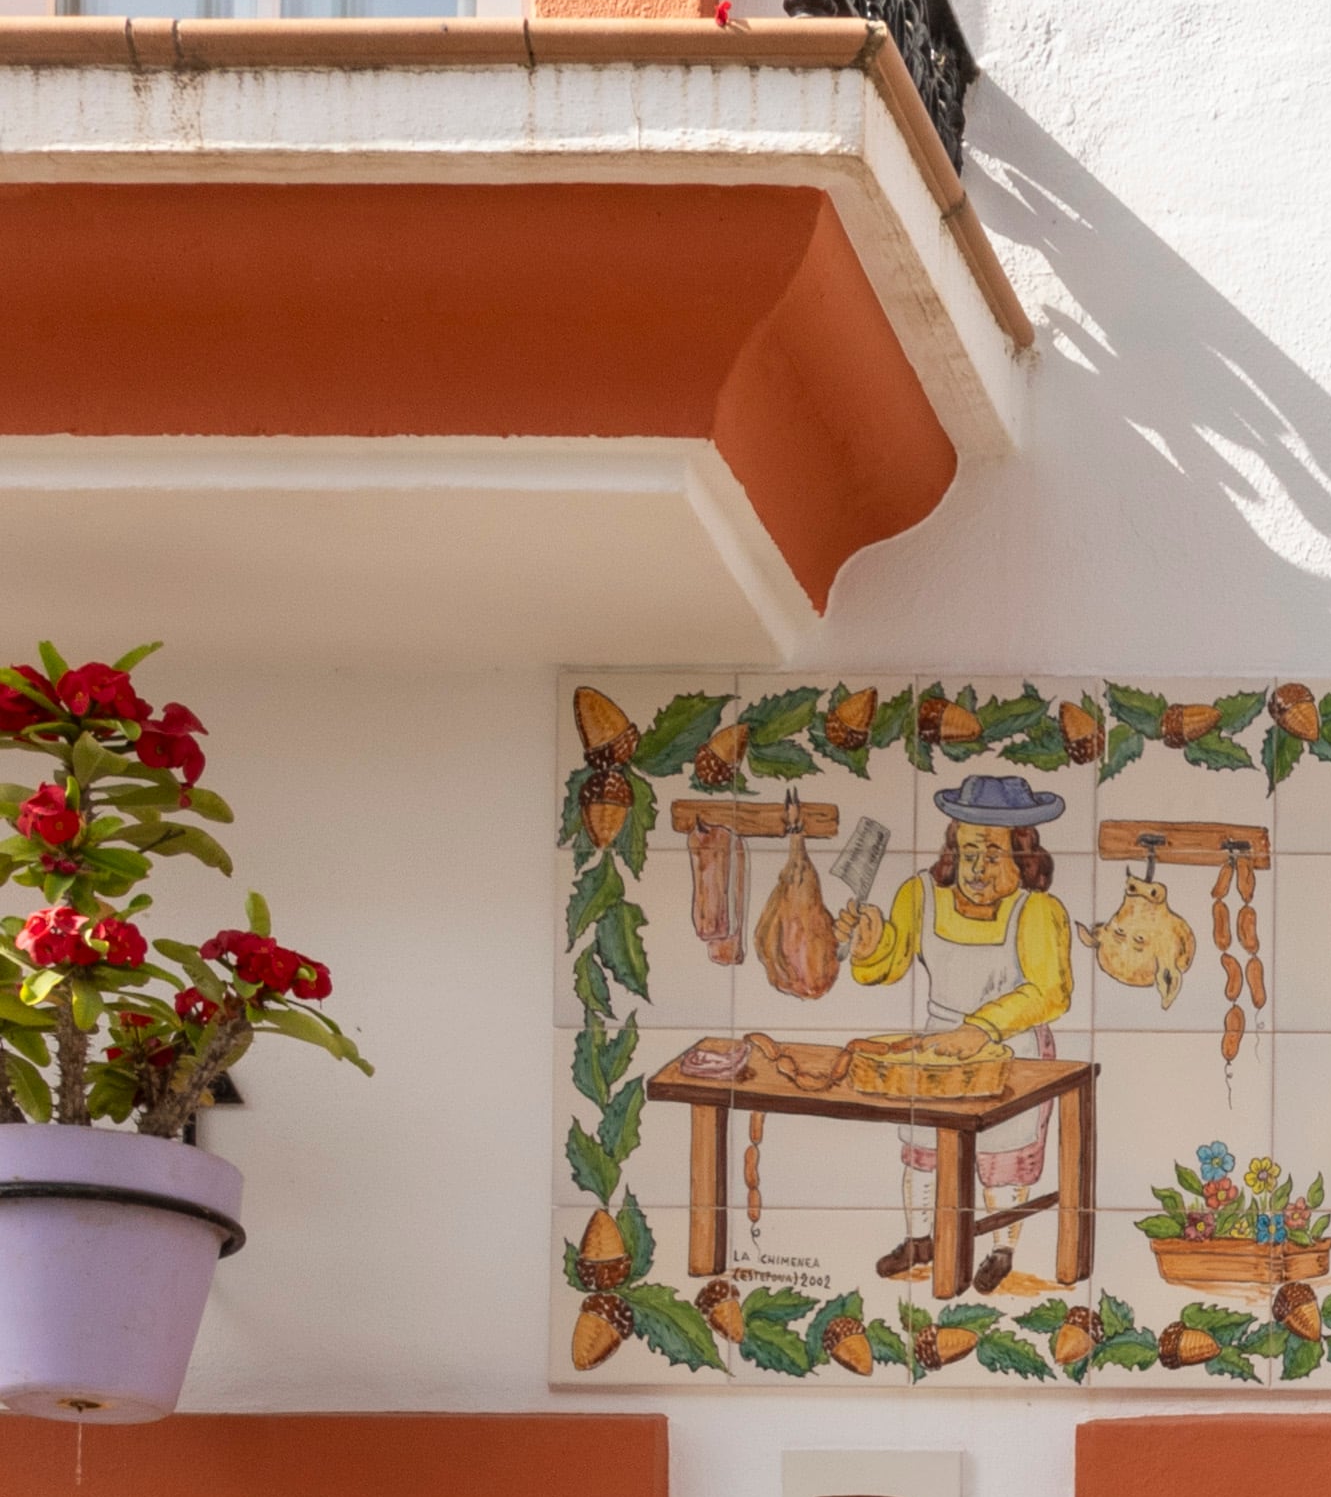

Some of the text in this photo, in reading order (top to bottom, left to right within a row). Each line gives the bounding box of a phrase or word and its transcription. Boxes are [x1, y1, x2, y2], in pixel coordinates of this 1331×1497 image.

[733, 1250, 821, 1269] LA CHIMENEA
[800, 1272, 831, 1290] 2002
